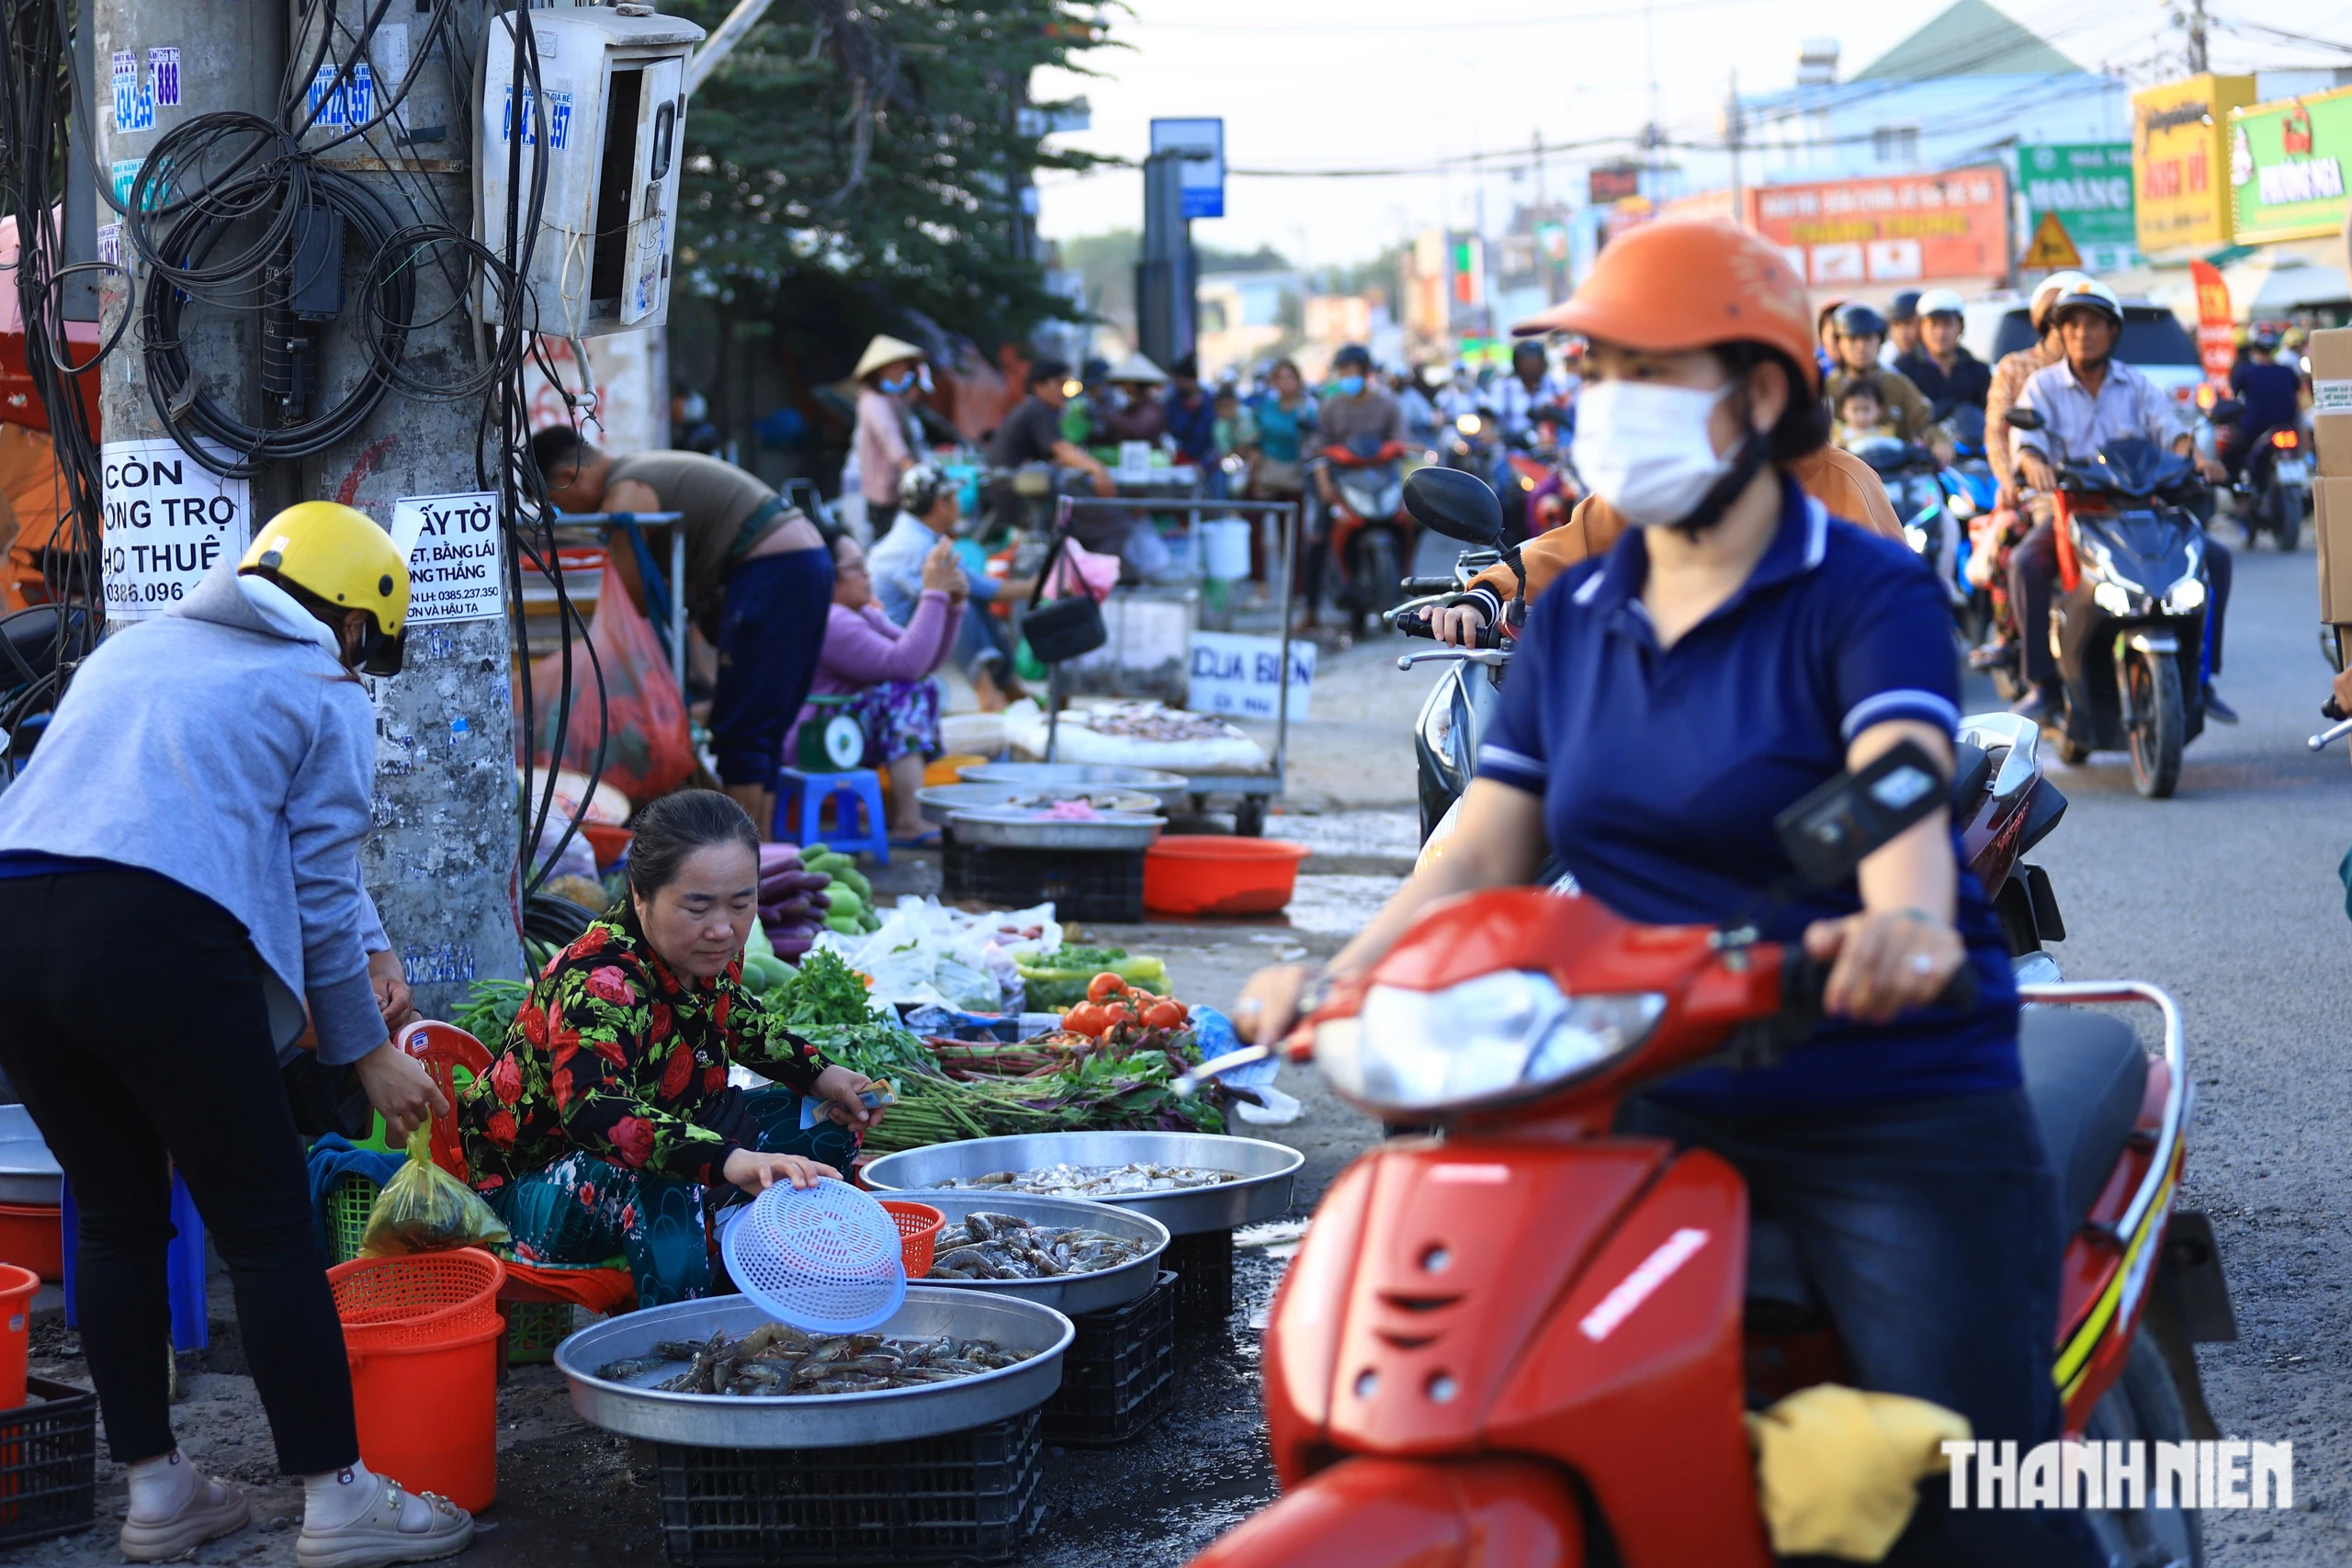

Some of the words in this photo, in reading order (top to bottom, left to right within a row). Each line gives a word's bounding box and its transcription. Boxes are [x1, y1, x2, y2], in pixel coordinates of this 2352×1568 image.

[106, 456, 183, 490] CÒN
[161, 495, 234, 532] TRỌ
[419, 503, 451, 536] ẤY
[455, 502, 492, 534] TỜ
[103, 546, 126, 575] HO
[131, 535, 220, 573] THUÊ
[433, 540, 473, 561] BẰNG
[475, 538, 495, 558] LÁI
[435, 560, 486, 581] THẮNG
[409, 592, 419, 604] N
[421, 592, 436, 603] LH:
[438, 586, 499, 602] 0385.237.350
[424, 604, 440, 616] VÀ
[441, 602, 464, 617] HẬU
[465, 603, 480, 615] TẠ
[1191, 646, 1245, 681] CUA
